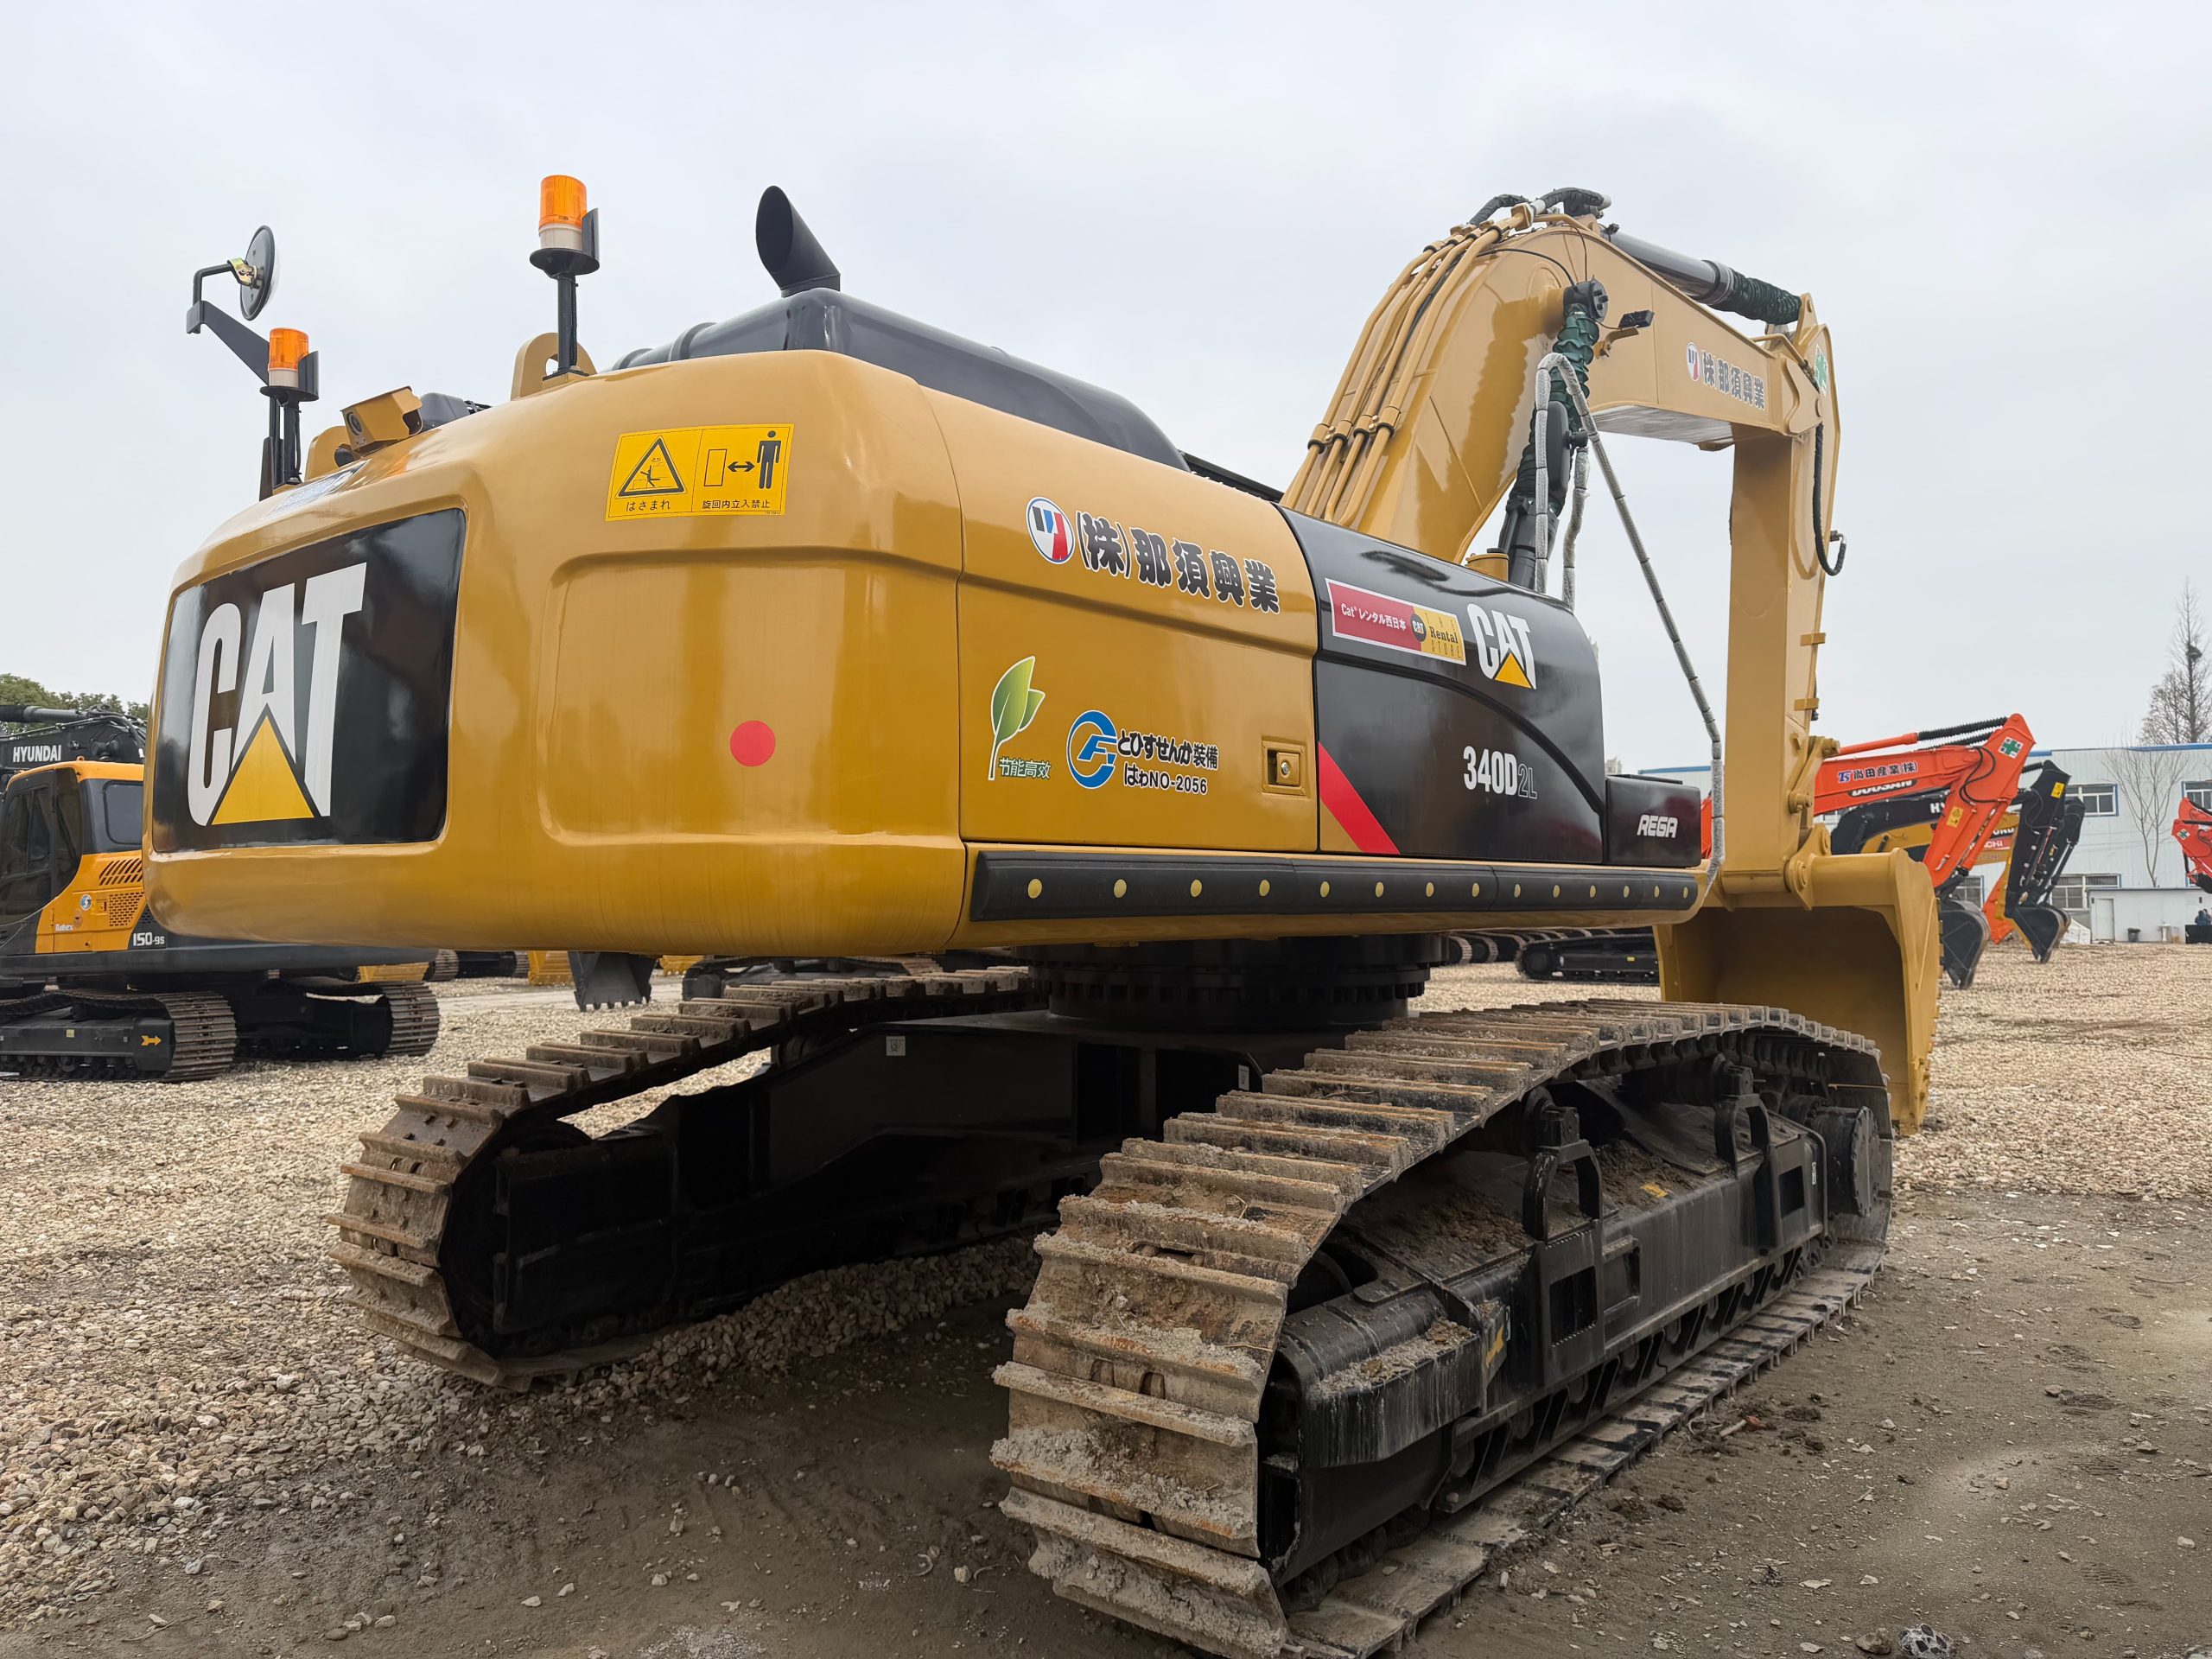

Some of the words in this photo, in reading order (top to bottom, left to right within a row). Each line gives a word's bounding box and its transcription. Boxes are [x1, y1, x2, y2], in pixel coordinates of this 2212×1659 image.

[626, 499, 671, 512] はさまれ
[702, 499, 771, 510] 旋回内立入禁止
[1358, 607, 1407, 631] レンタル西日本
[1412, 620, 1425, 634] CAT
[1429, 625, 1459, 644] Rental
[1466, 603, 1536, 690] CAT
[188, 562, 367, 827] CAT
[13, 744, 62, 763] HYUNDAI
[999, 756, 1052, 779] 节能高效
